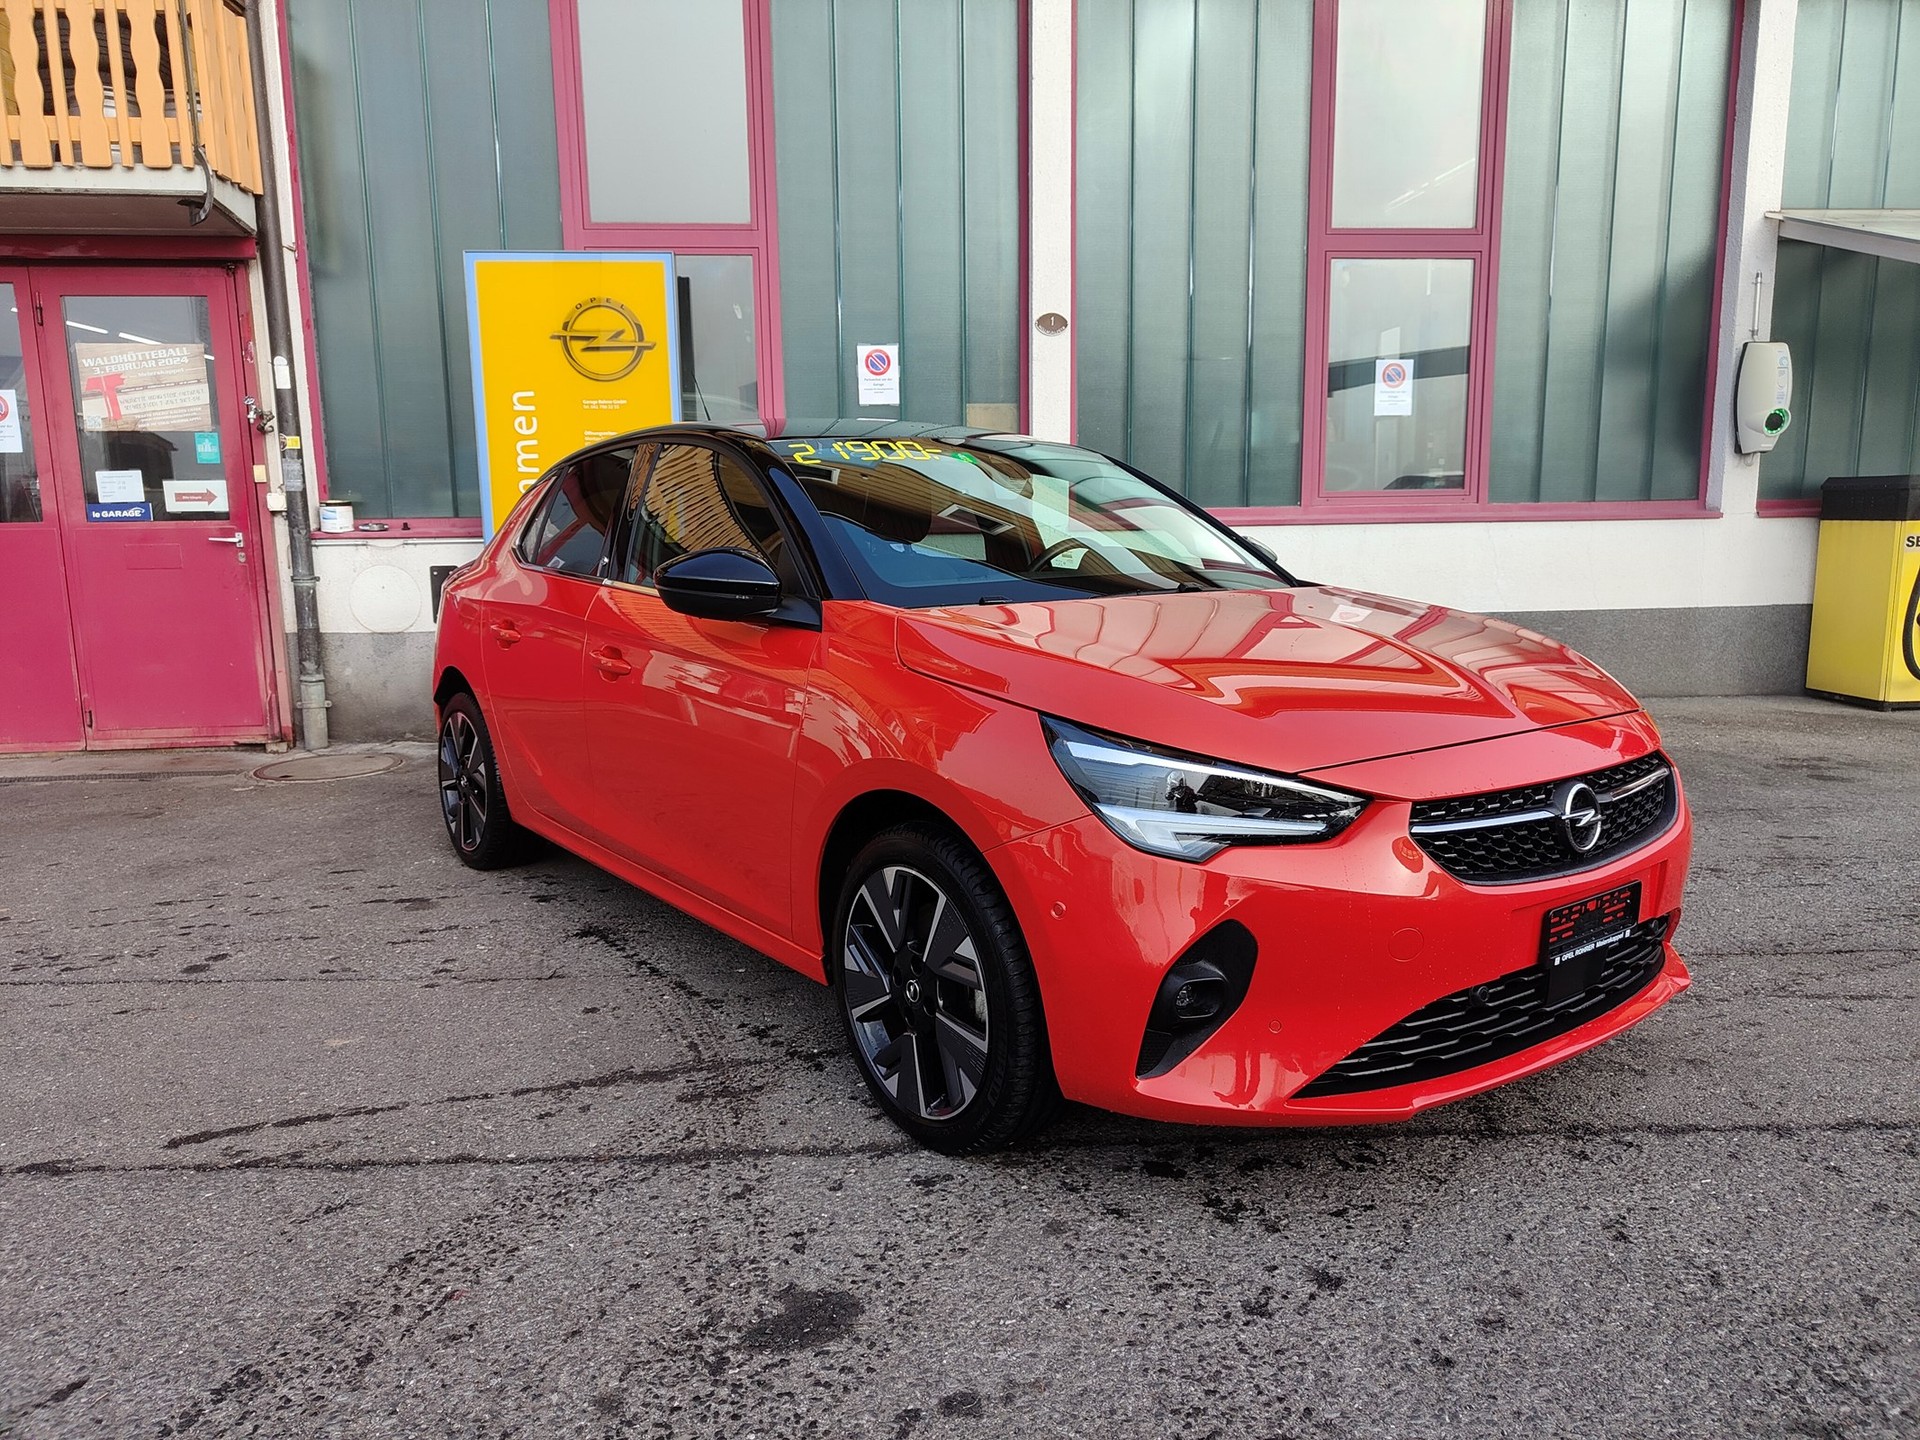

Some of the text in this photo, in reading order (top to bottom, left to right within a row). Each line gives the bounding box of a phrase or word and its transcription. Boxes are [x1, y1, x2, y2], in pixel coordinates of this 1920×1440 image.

[575, 297, 625, 310] OPEL
[1050, 316, 1055, 327] 1
[106, 360, 156, 373] FEBRUAR
[158, 356, 189, 368] 2024
[101, 510, 142, 518] GARAGE
[1561, 951, 1575, 961] OPEL
